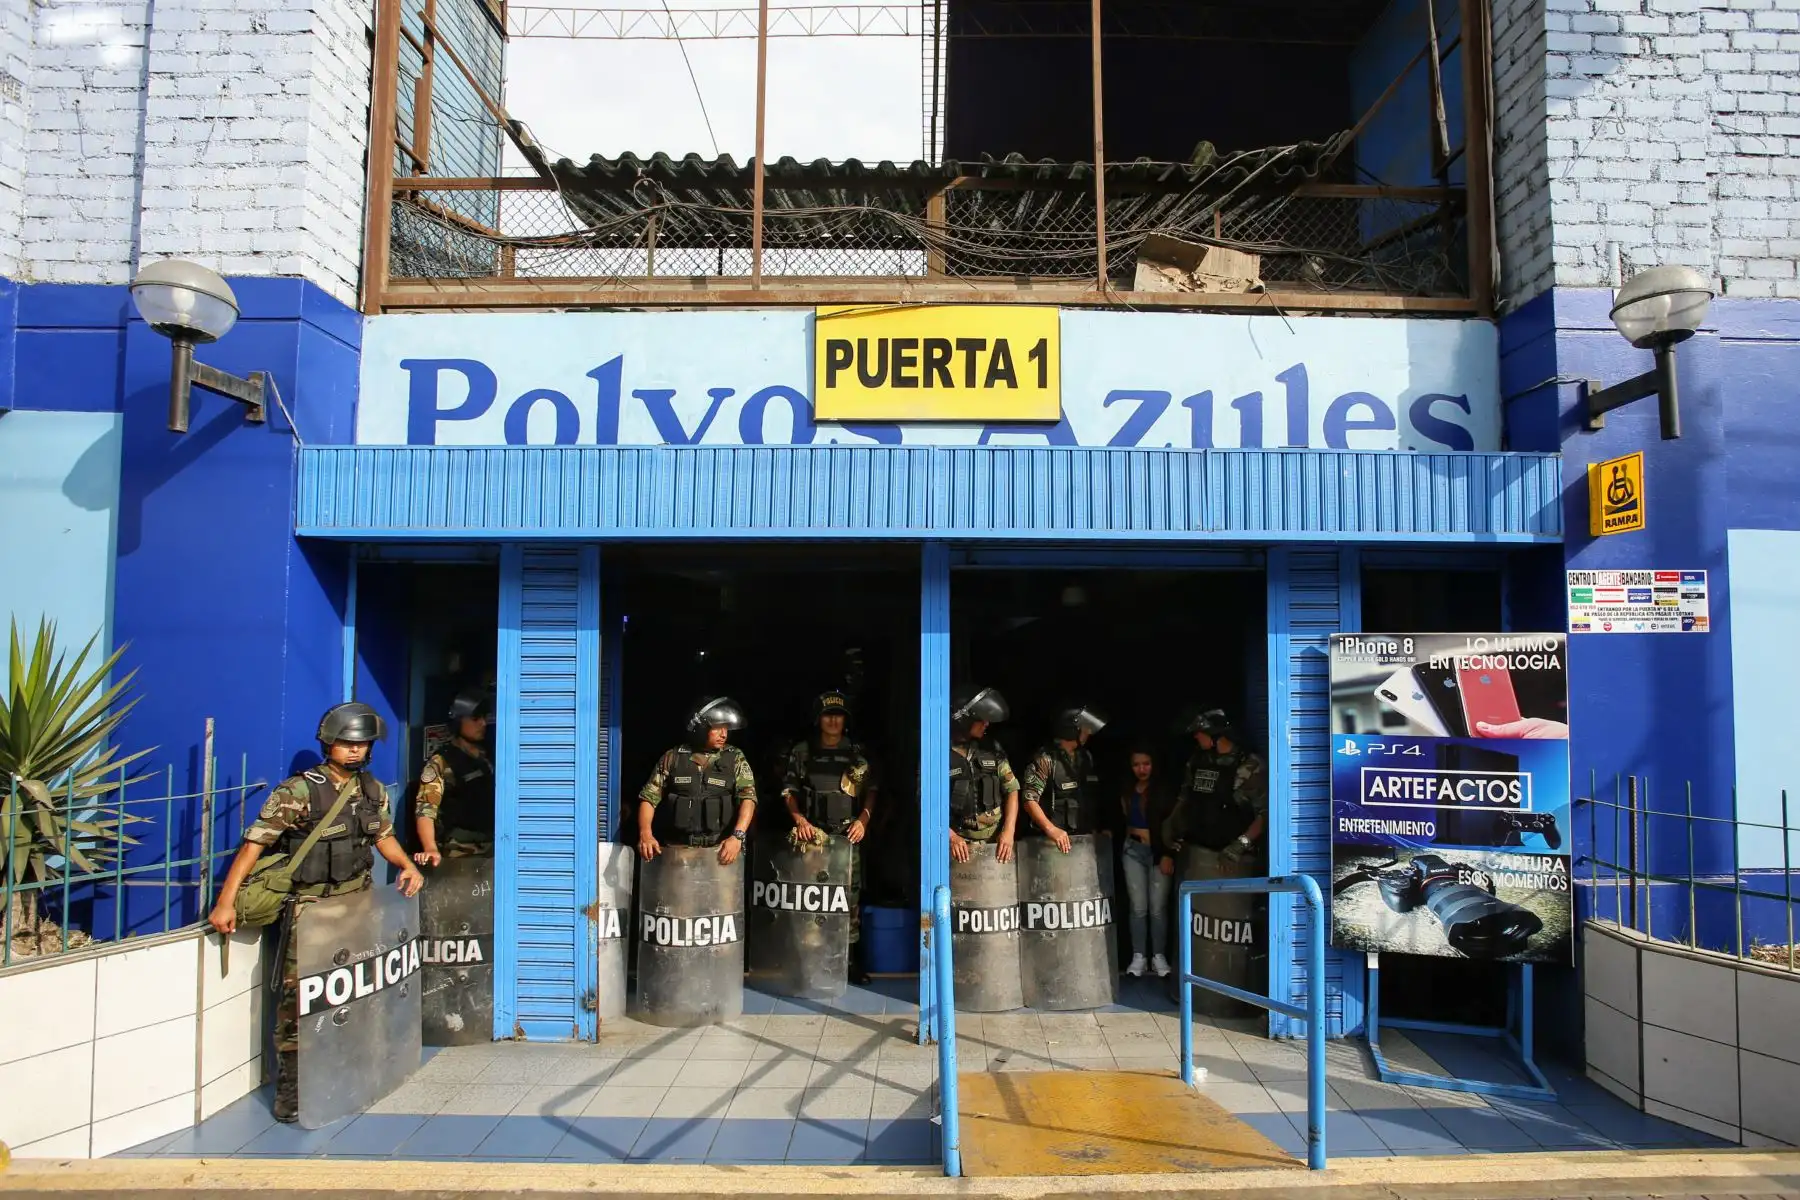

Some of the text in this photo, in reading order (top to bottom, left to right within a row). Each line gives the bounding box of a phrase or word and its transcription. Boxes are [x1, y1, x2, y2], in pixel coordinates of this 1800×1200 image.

[825, 338, 1048, 389] PUERTA 1
[1604, 513, 1638, 529] RAMPA
[1568, 572, 1591, 586] CENTRO
[1339, 638, 1414, 655] iPhone 8
[1467, 637, 1558, 652] LO ULTIMO
[1429, 655, 1561, 670] EN TECNOLOGIA
[1369, 776, 1522, 803] ARTEFACTOS
[1339, 817, 1435, 837] ENTRETENIMIENTO
[1486, 853, 1566, 873] CAPTURA
[1458, 870, 1568, 891] ESOS MOMENTOS
[753, 880, 850, 912] POLICIA
[1027, 898, 1112, 929] POLICIA
[643, 914, 737, 947] POLICIA
[421, 938, 484, 963] LICIA
[299, 938, 421, 1016] POLICIA
